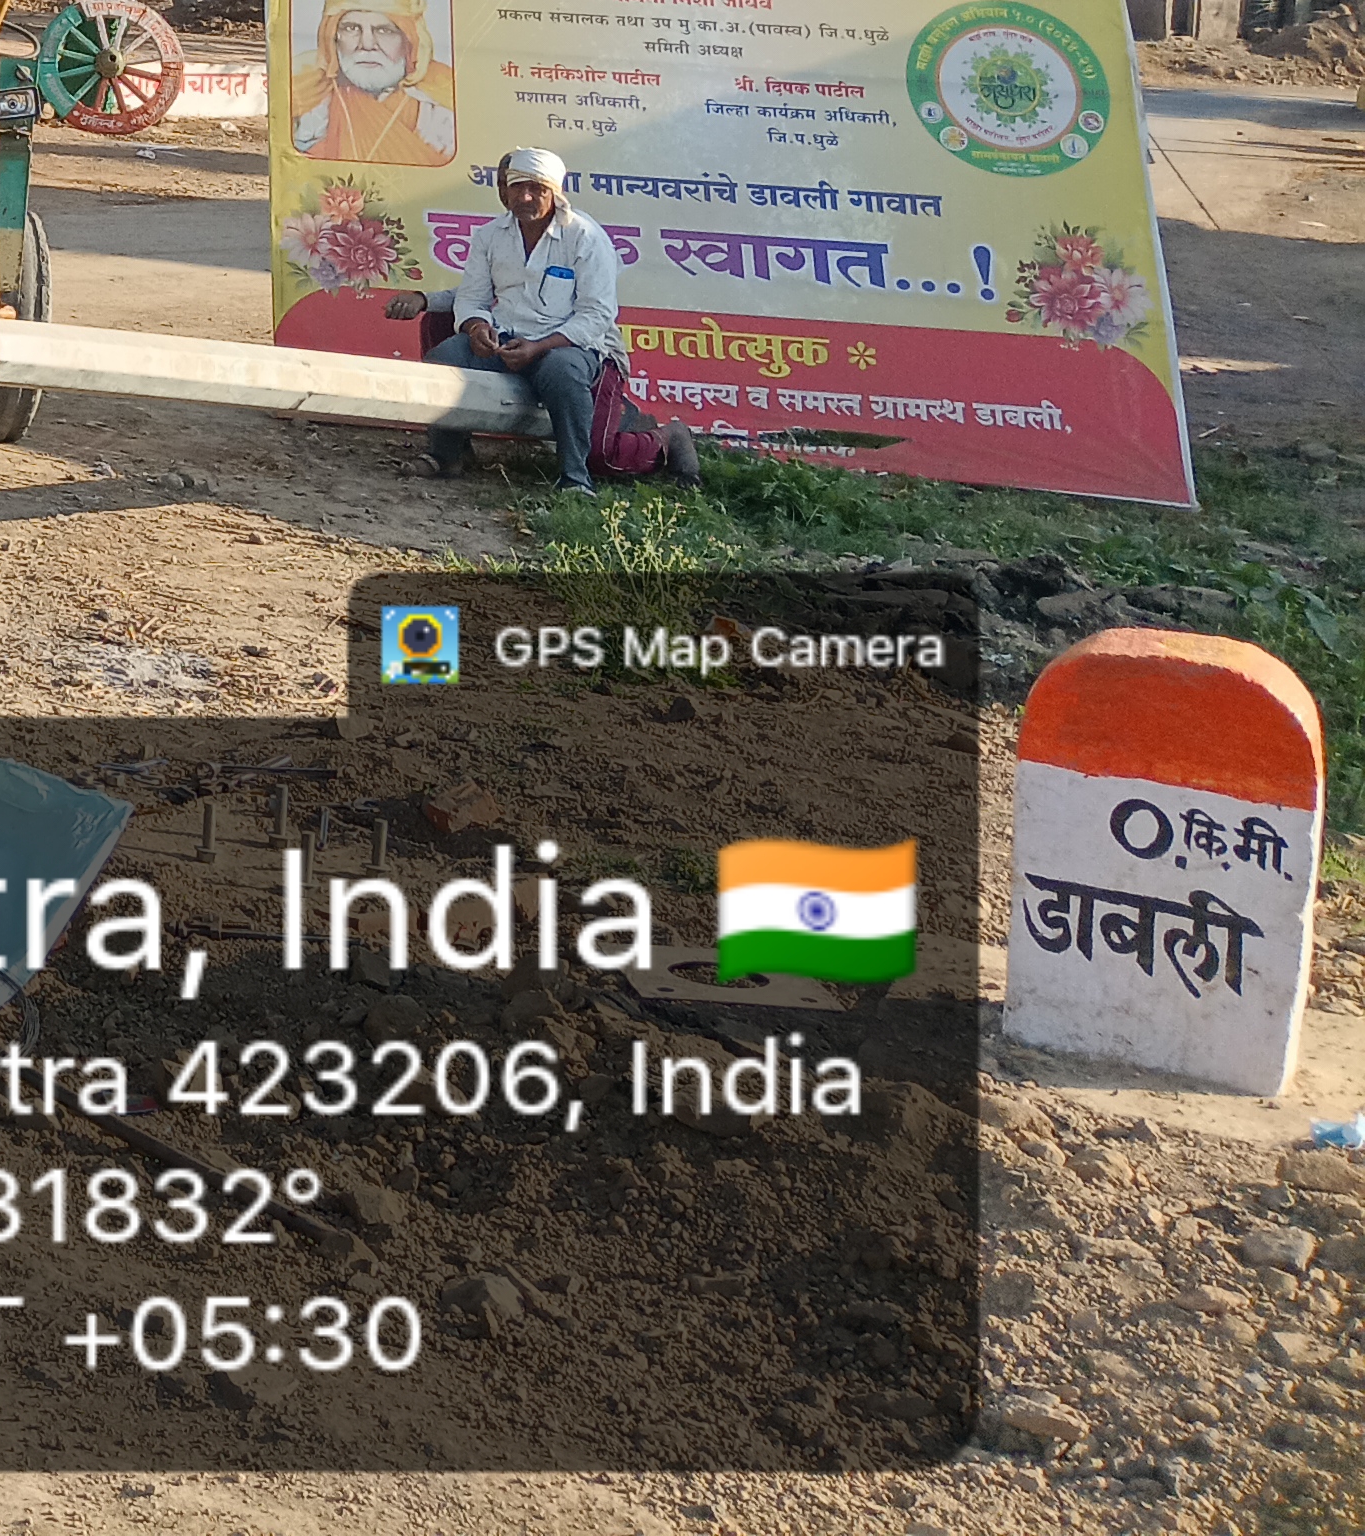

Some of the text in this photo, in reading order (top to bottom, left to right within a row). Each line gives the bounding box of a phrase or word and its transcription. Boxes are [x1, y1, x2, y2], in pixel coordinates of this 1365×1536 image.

[496, 7, 543, 22] प्रकल्प
[548, 6, 610, 26] संचालक
[615, 14, 645, 28] तथा
[650, 16, 672, 30] उप
[642, 37, 744, 59] समिती अध्यक्ष
[499, 60, 663, 87] श्री. नंदकिशोर पाटील
[513, 89, 568, 106] प्रशासन
[734, 74, 867, 99] श्री. दिपक पाटील
[704, 98, 750, 117] जिल्हा
[755, 101, 816, 121] कार्यक्रम
[589, 171, 738, 205] मान्यवरांचे
[745, 179, 840, 212] डाबली
[846, 189, 944, 218] गावात
[745, 385, 770, 410] व
[776, 387, 863, 417] समस्त
[868, 394, 966, 424] ग्रामस्थ
[1022, 871, 1266, 1000] डाबली
